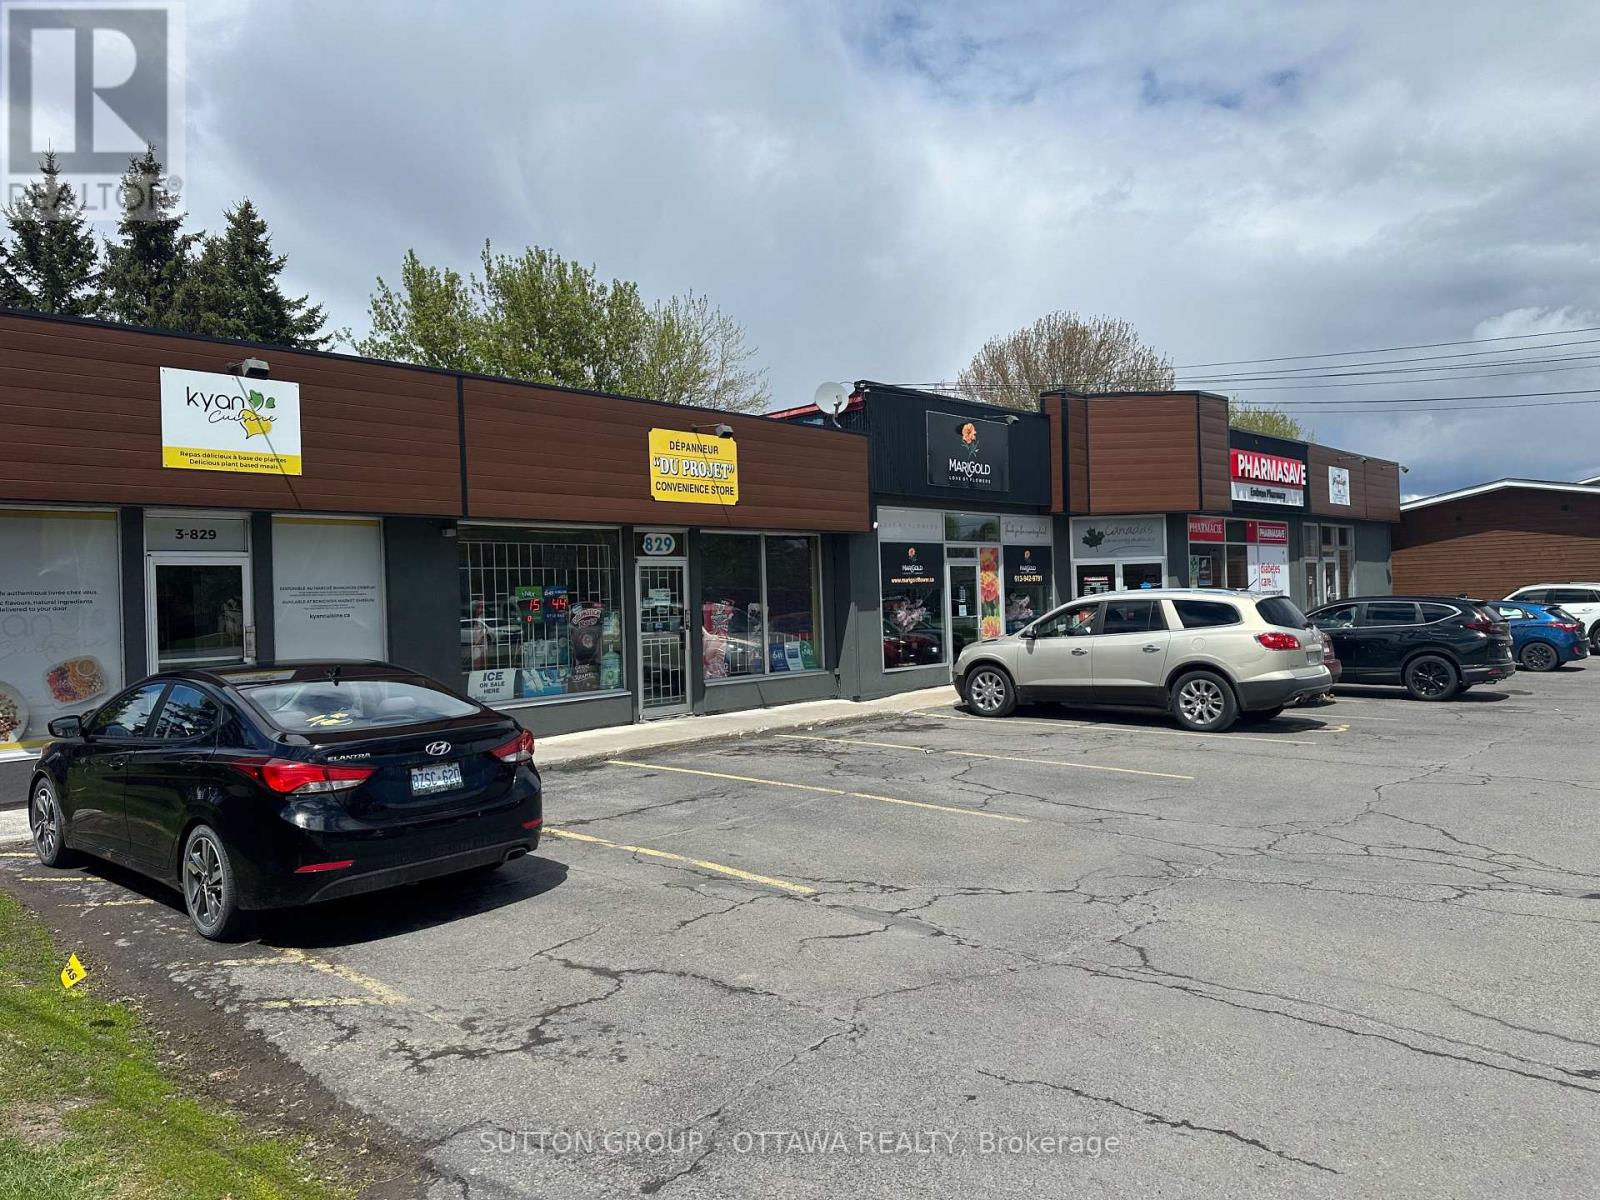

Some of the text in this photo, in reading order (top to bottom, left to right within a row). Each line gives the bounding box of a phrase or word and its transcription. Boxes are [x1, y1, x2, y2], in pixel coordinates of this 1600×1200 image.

[186, 386, 245, 412] kyan
[208, 410, 277, 424] Cuisine
[669, 439, 719, 454] DÉPANNEUR
[1238, 454, 1306, 486] PHARMASAVE
[656, 481, 734, 496] CONVENIENCE STORE
[175, 528, 216, 540] 3-829
[1189, 522, 1222, 534] PHARMACIE
[644, 536, 673, 552] 829
[483, 672, 504, 681] ICE
[328, 753, 370, 761] ELANTRA
